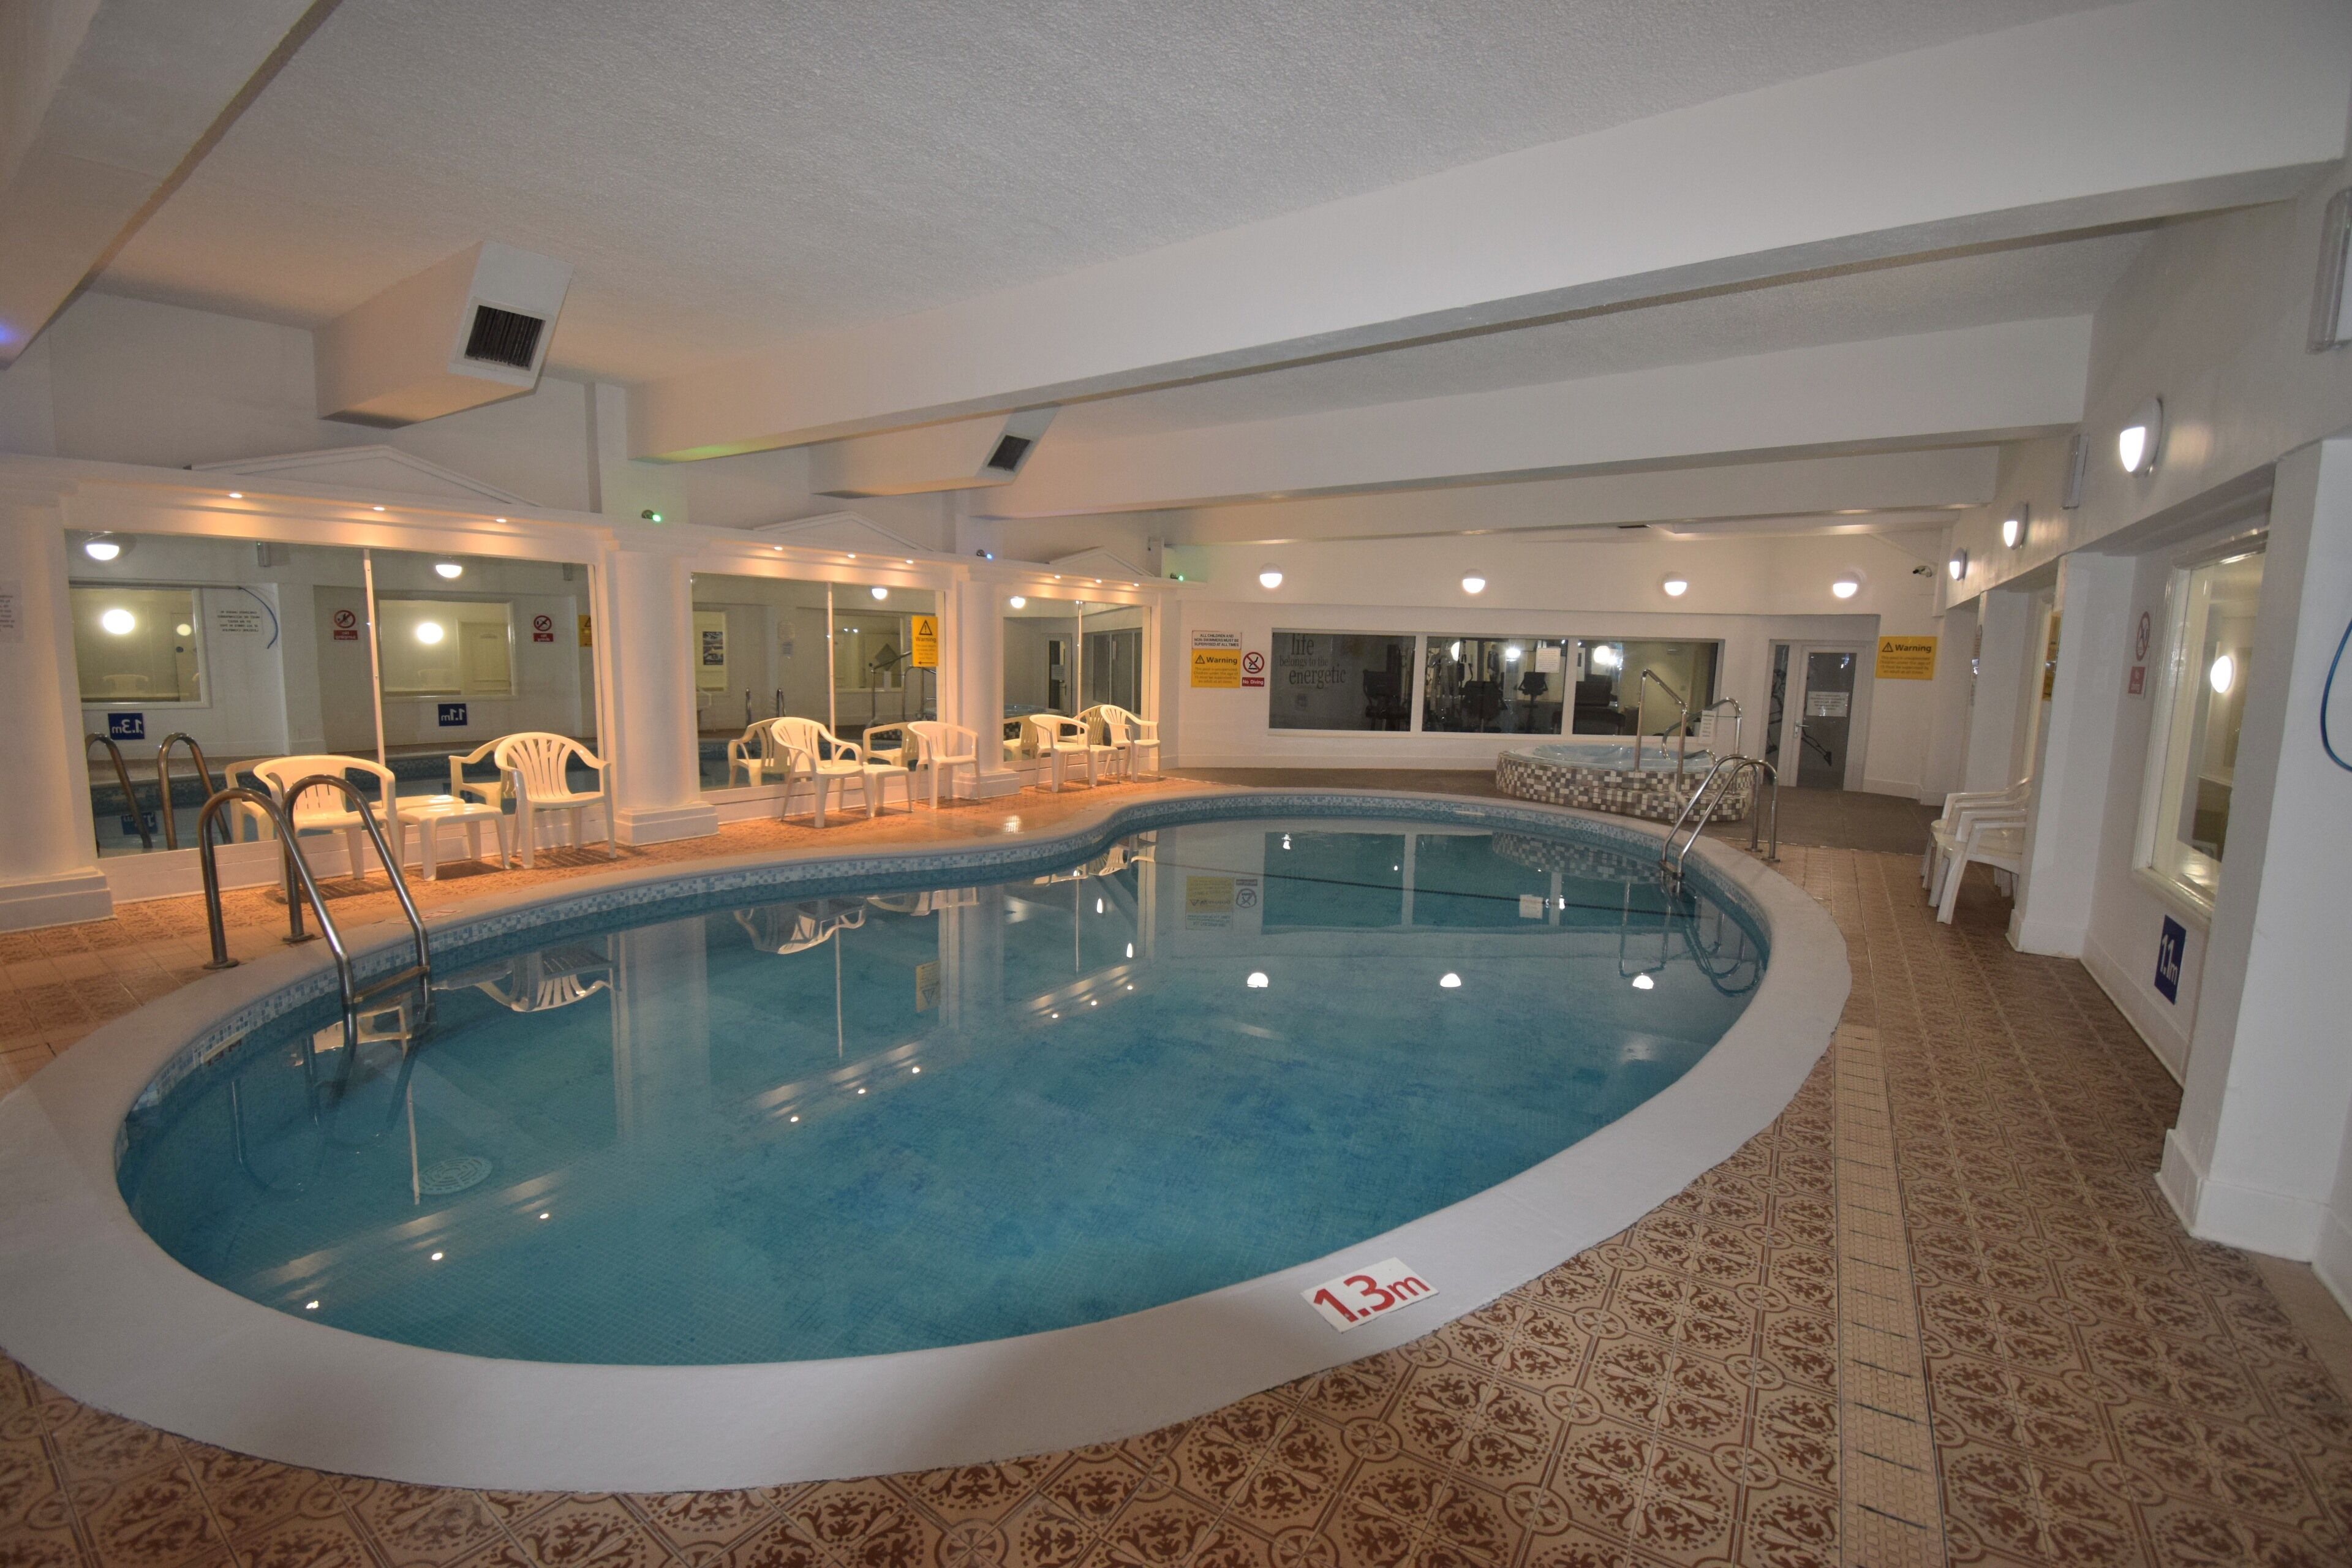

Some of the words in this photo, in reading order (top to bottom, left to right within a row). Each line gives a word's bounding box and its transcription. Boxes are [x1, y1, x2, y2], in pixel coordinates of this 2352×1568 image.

[1291, 633, 1314, 655] life
[1895, 644, 1932, 654] Warning
[1206, 657, 1237, 665] Warning
[1280, 655, 1307, 669] belongs
[1289, 664, 1346, 689] energetic
[2160, 933, 2178, 986] 1.1m
[1313, 1275, 1431, 1322] 1.3m
